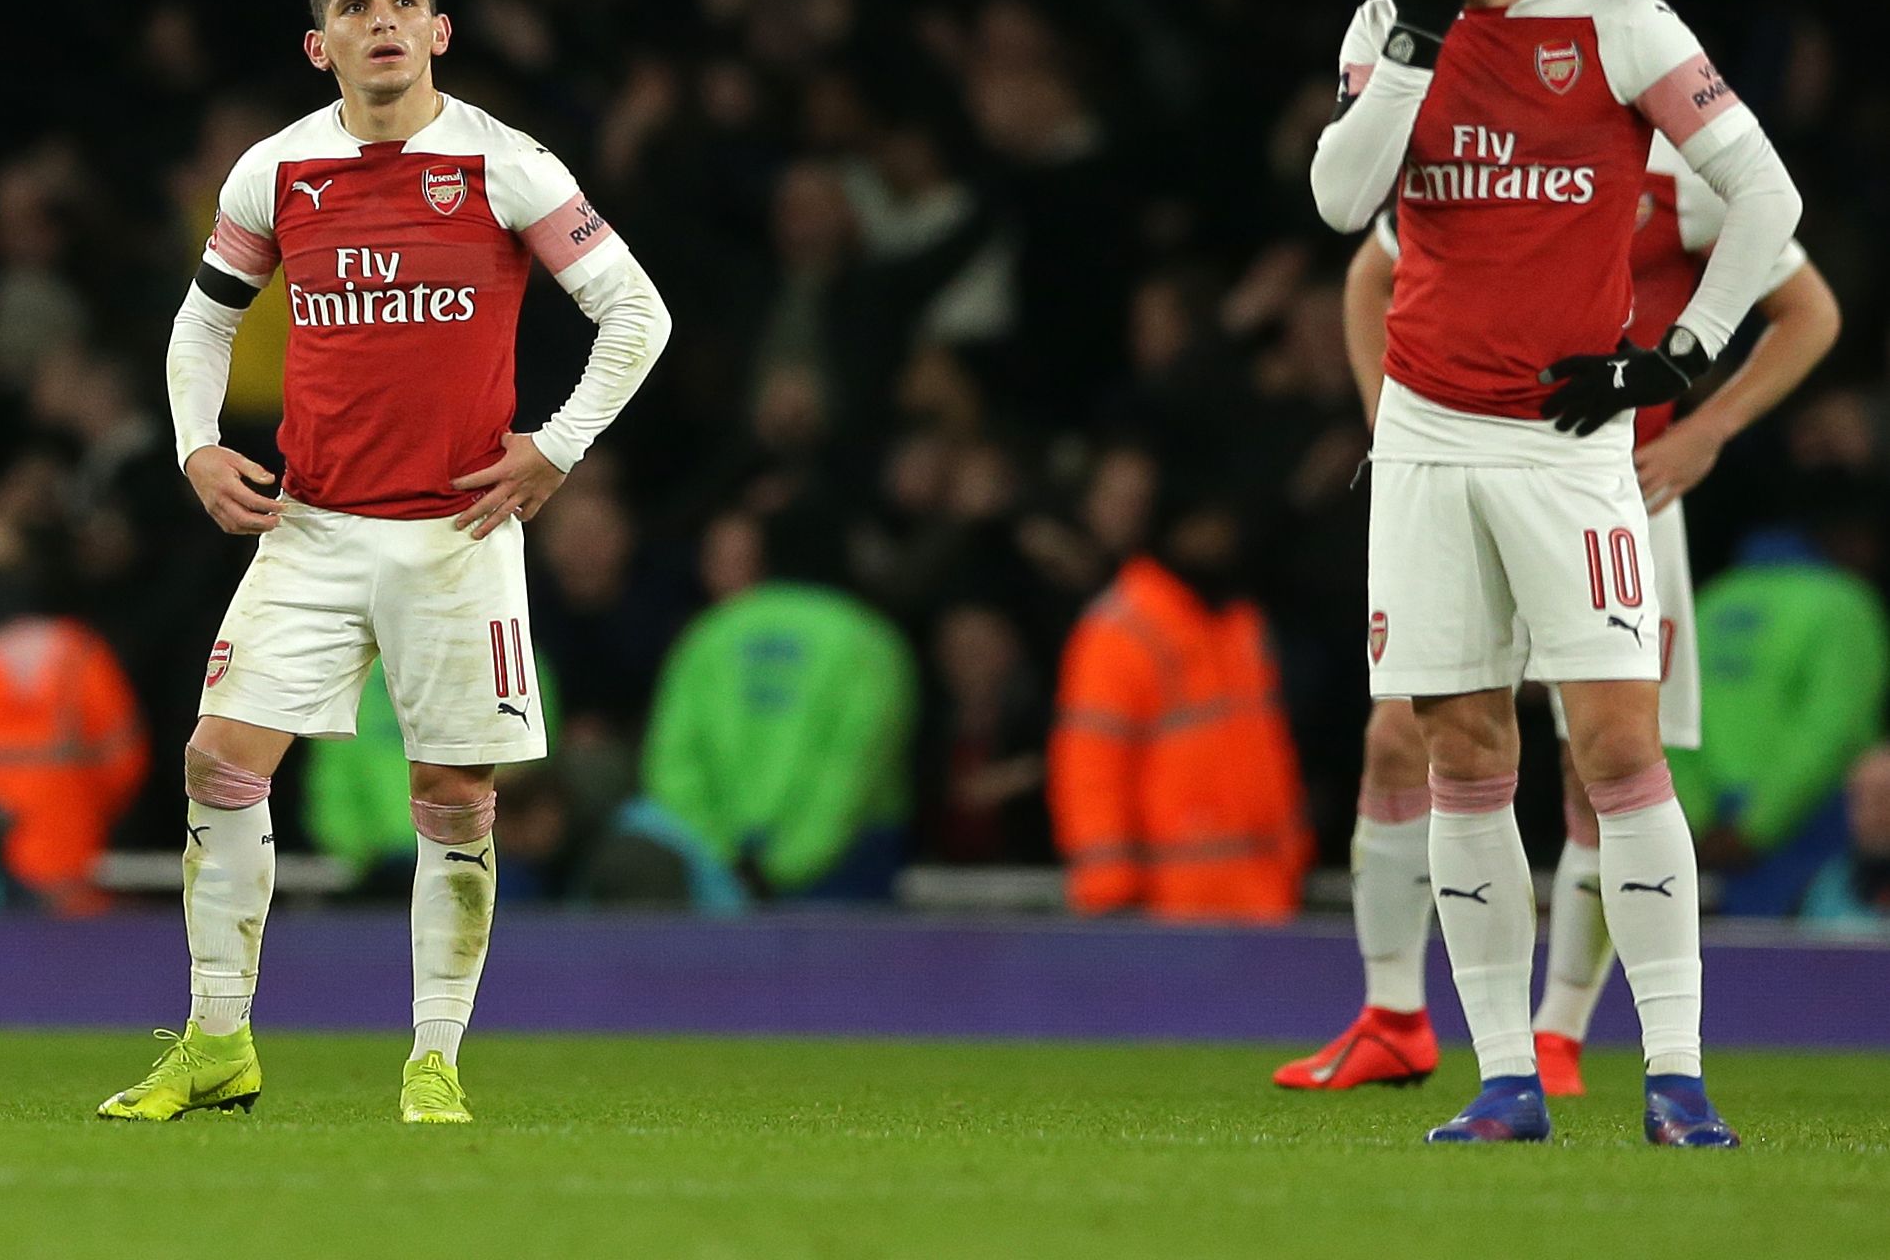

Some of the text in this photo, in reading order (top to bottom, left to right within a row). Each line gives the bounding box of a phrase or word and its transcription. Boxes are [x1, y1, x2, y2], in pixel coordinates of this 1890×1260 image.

[1452, 124, 1516, 166] Fly
[428, 170, 462, 183] Arsenal
[1402, 162, 1595, 205] Emirates
[336, 247, 401, 284] Fly
[289, 281, 476, 327] Emirates
[1583, 526, 1644, 610] 10
[489, 617, 528, 699] 11
